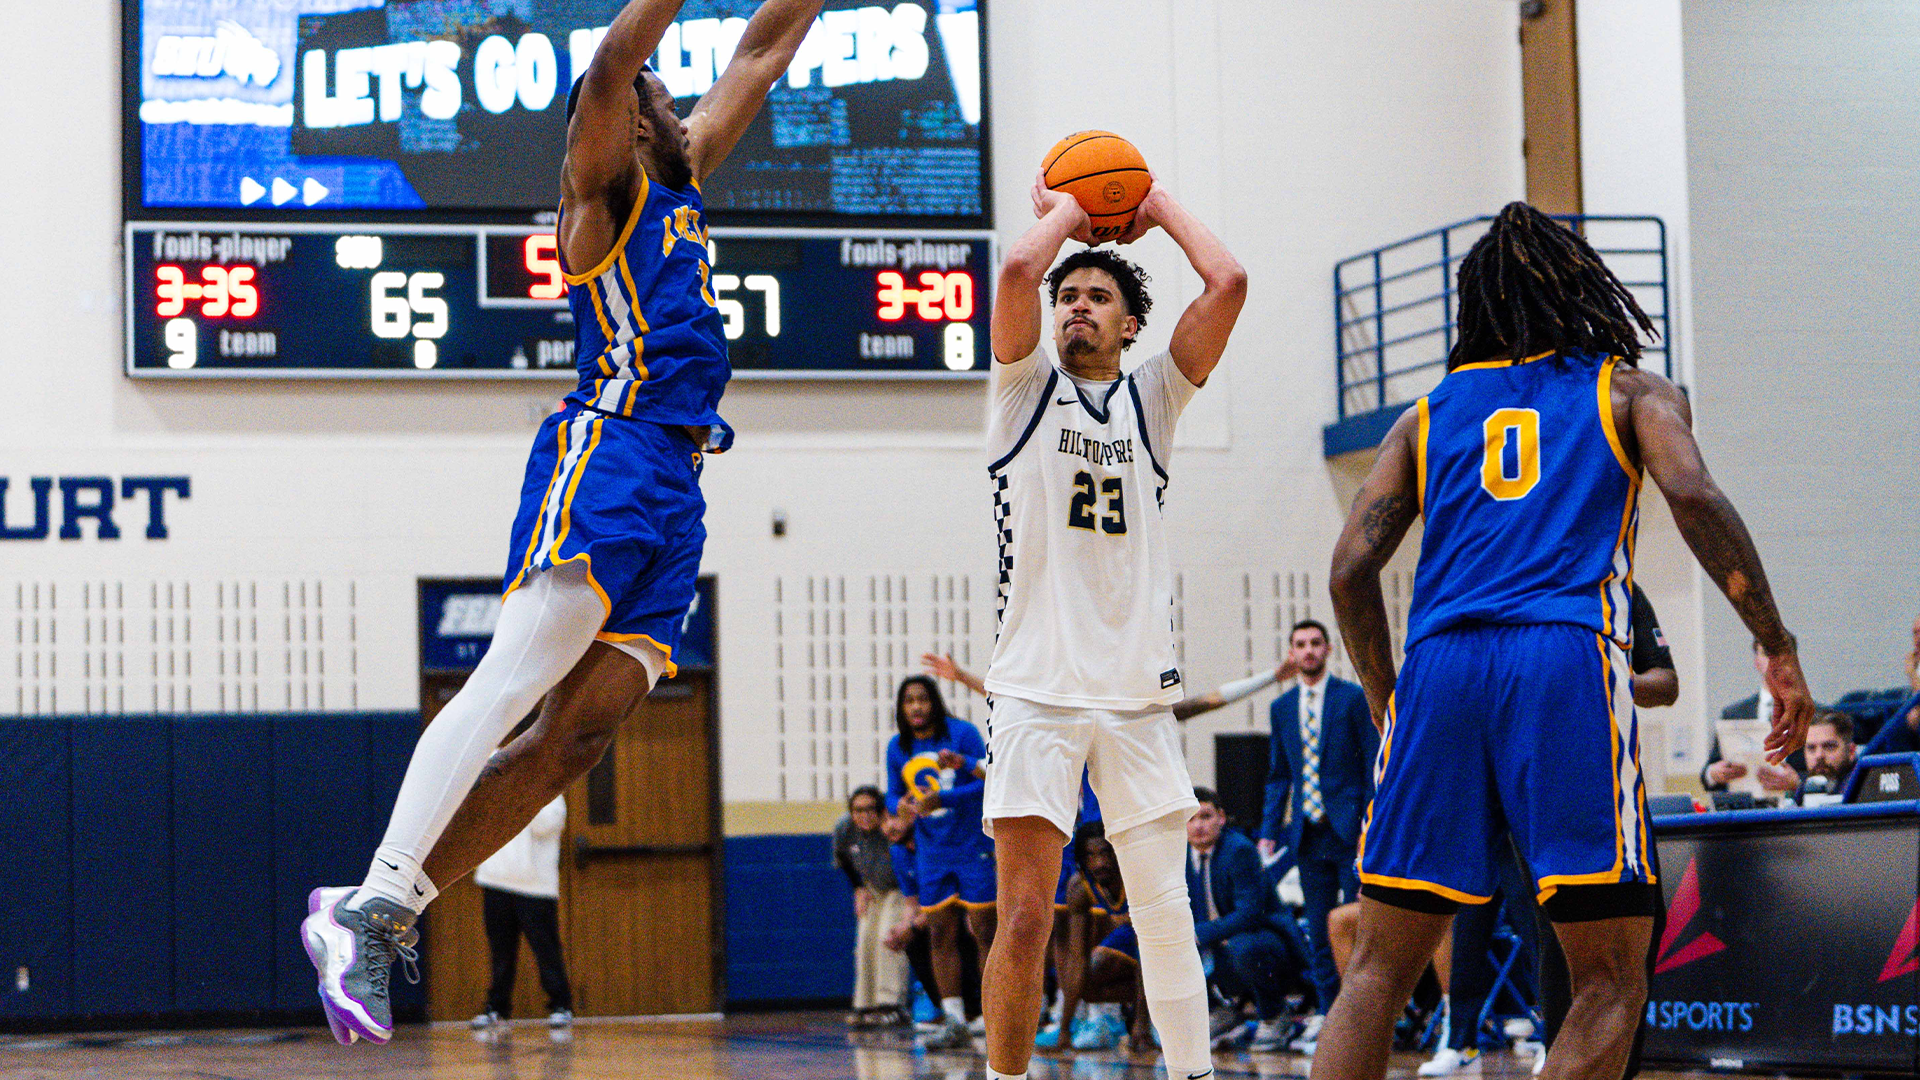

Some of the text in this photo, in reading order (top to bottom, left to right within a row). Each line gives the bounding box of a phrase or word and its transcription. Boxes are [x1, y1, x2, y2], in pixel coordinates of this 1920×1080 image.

[303, 39, 461, 128] LET'S
[474, 33, 557, 114] GO
[153, 233, 292, 265] fouls-player
[525, 234, 569, 299] 5
[840, 237, 972, 271] fouls-player
[156, 265, 259, 318] 3-35
[371, 272, 448, 338] 65
[876, 270, 974, 321] 3-20
[165, 318, 197, 370] 9
[219, 330, 277, 357] team
[858, 332, 914, 359] team
[944, 322, 975, 371] 8
[1480, 407, 1541, 502] 0
[0, 476, 191, 540] URT
[1067, 468, 1128, 536] 23
[1660, 1001, 1753, 1031] SPORTS
[1832, 1003, 1920, 1036] BSN S
